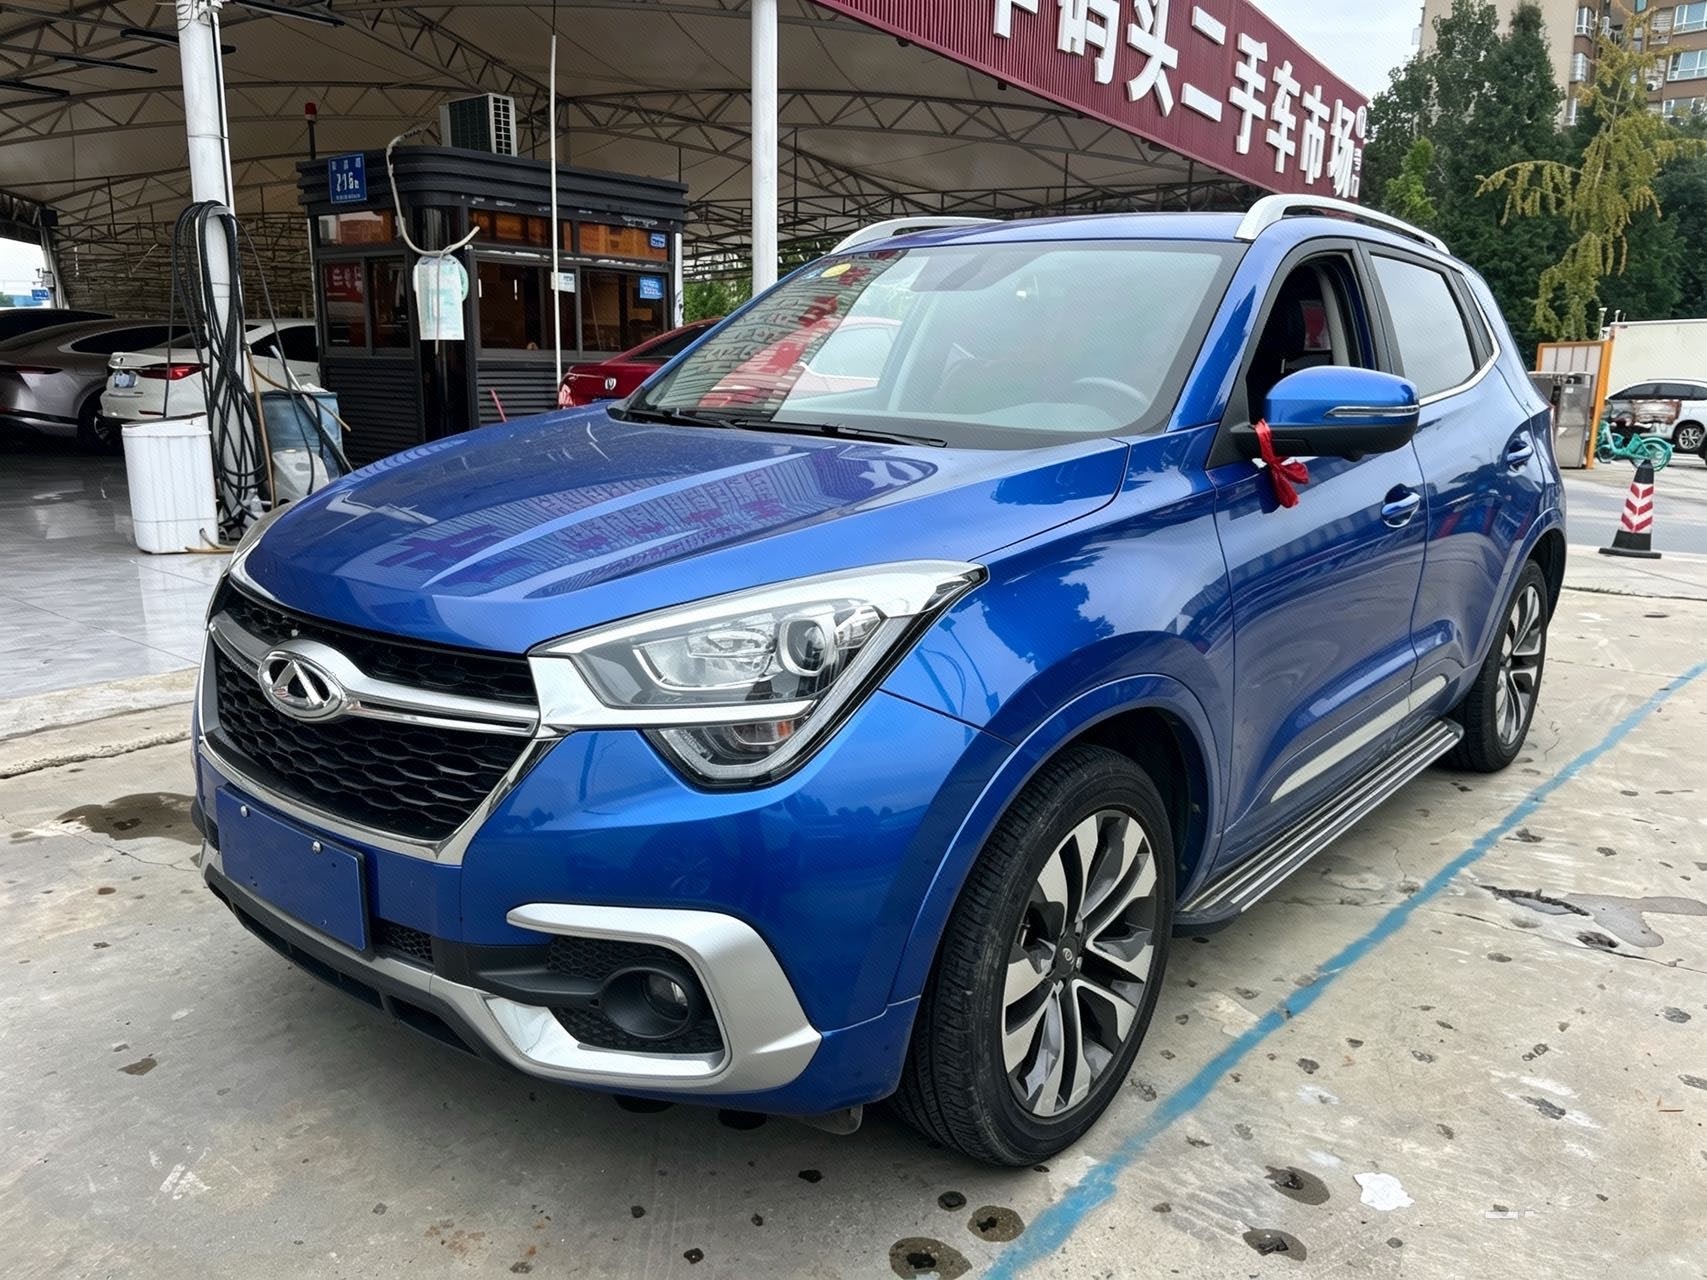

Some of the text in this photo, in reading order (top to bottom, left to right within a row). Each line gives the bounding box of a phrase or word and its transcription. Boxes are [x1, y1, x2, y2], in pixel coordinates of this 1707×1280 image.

[993, 0, 1356, 198] 码头二手车市场
